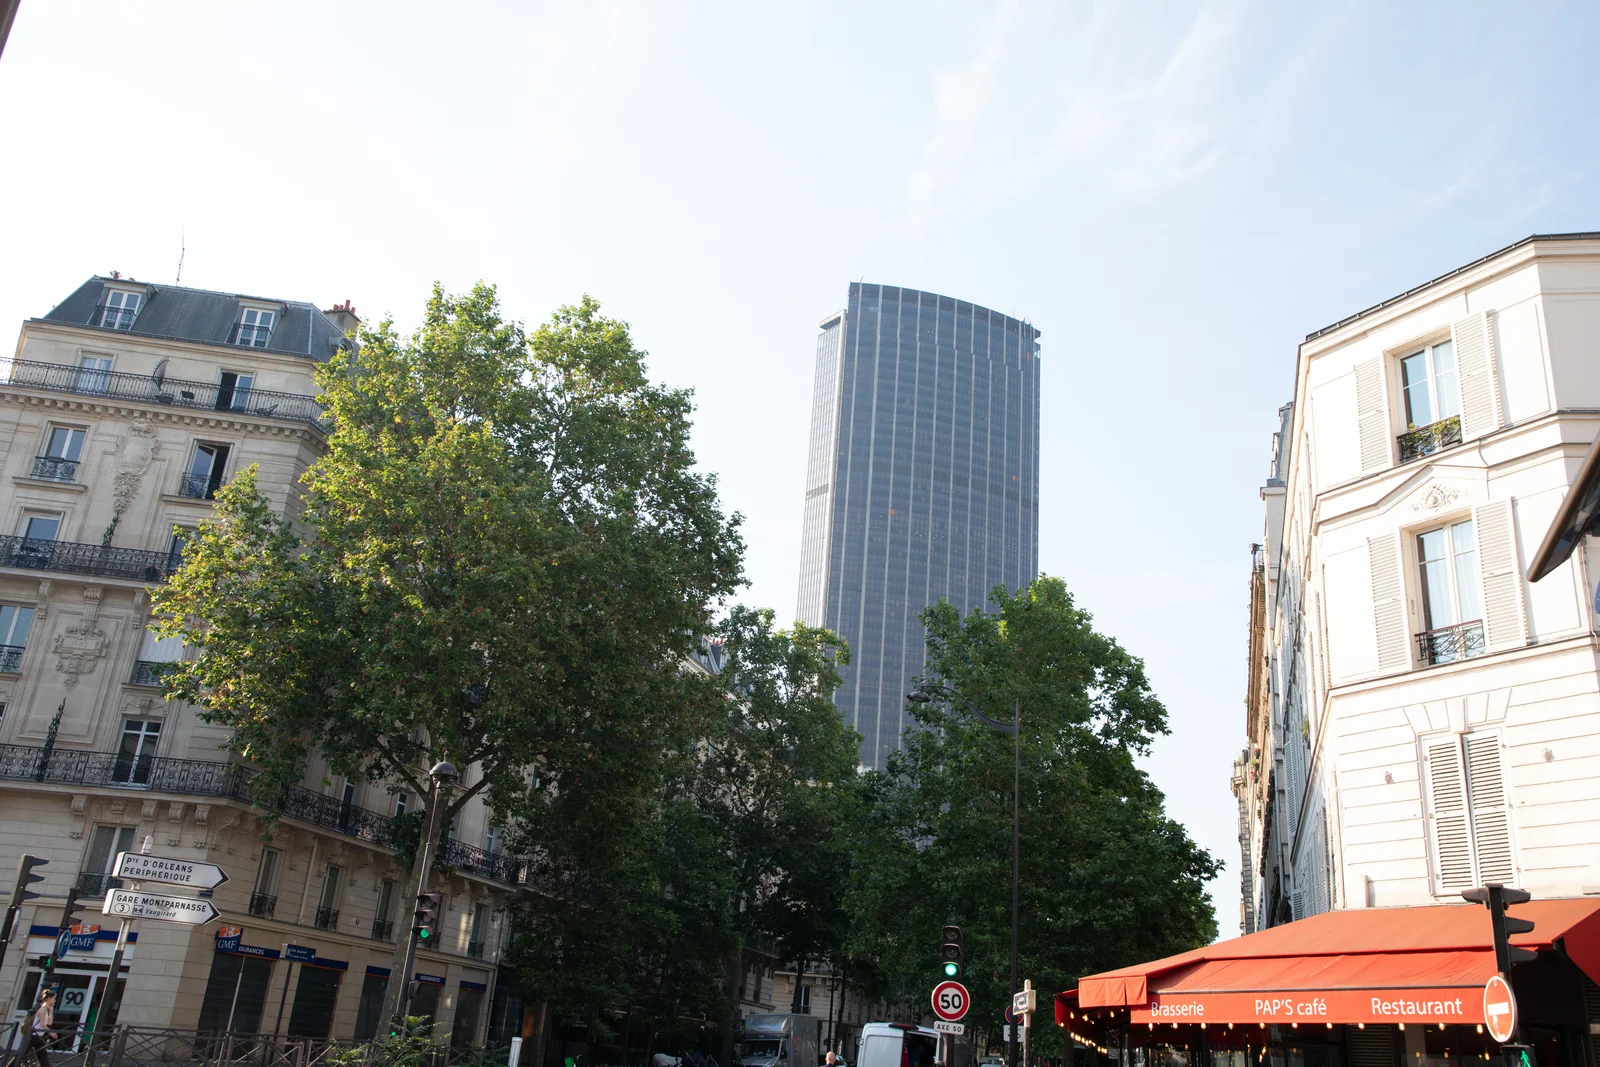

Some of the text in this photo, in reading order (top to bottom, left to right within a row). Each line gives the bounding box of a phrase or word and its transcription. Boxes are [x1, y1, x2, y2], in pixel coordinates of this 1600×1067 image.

[143, 859, 193, 873] D'ORLEANS
[124, 866, 191, 882] PERIPHERIQUE
[117, 894, 207, 912] GARE MONTPARNASSE
[119, 904, 125, 912] 3
[145, 908, 177, 918] Vaugirard
[70, 936, 95, 947] GMF
[217, 939, 237, 950] GMF
[238, 945, 265, 955] SSURANCES
[65, 991, 84, 1005] 90
[940, 993, 962, 1009] 50
[1151, 1001, 1205, 1017] Brasserie
[1255, 998, 1327, 1016] PAP'S café
[1371, 997, 1463, 1015] Restaurant
[936, 1023, 949, 1031] AXE
